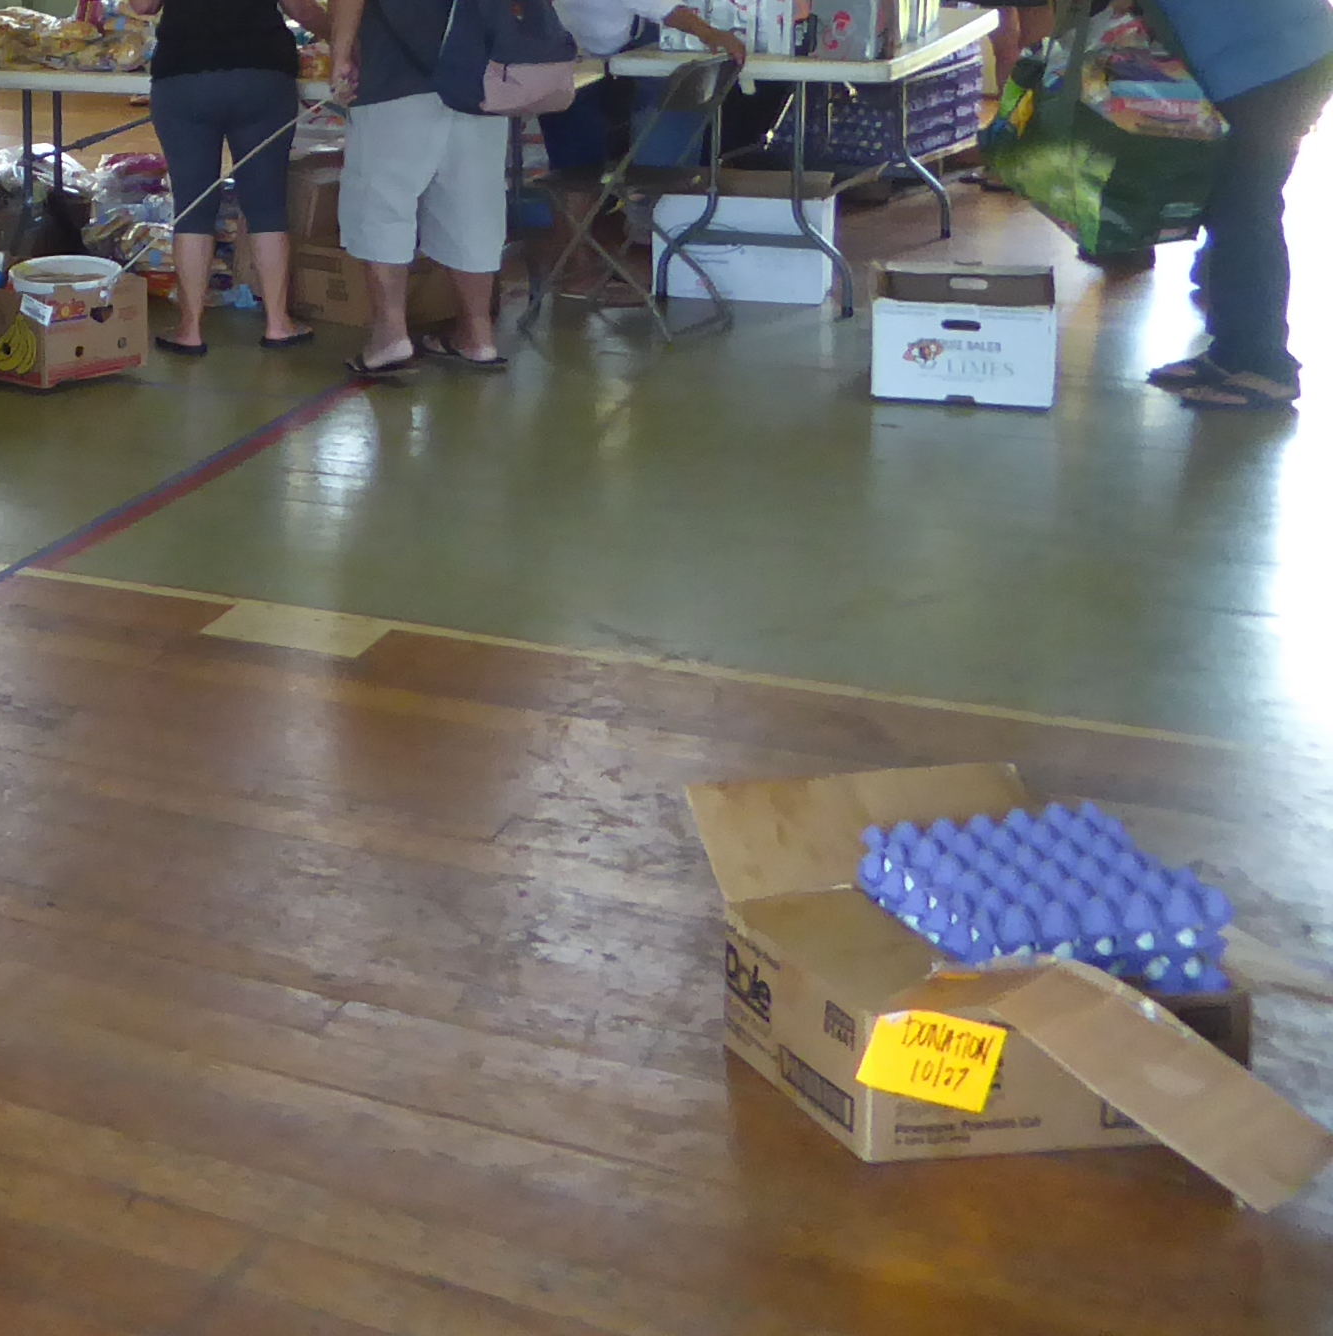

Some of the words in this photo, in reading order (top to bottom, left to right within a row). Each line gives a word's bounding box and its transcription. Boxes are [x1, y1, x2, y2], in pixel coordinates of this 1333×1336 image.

[726, 940, 771, 1010] Dole
[901, 1015, 995, 1066] DONATION
[910, 1056, 970, 1091] 10/27
